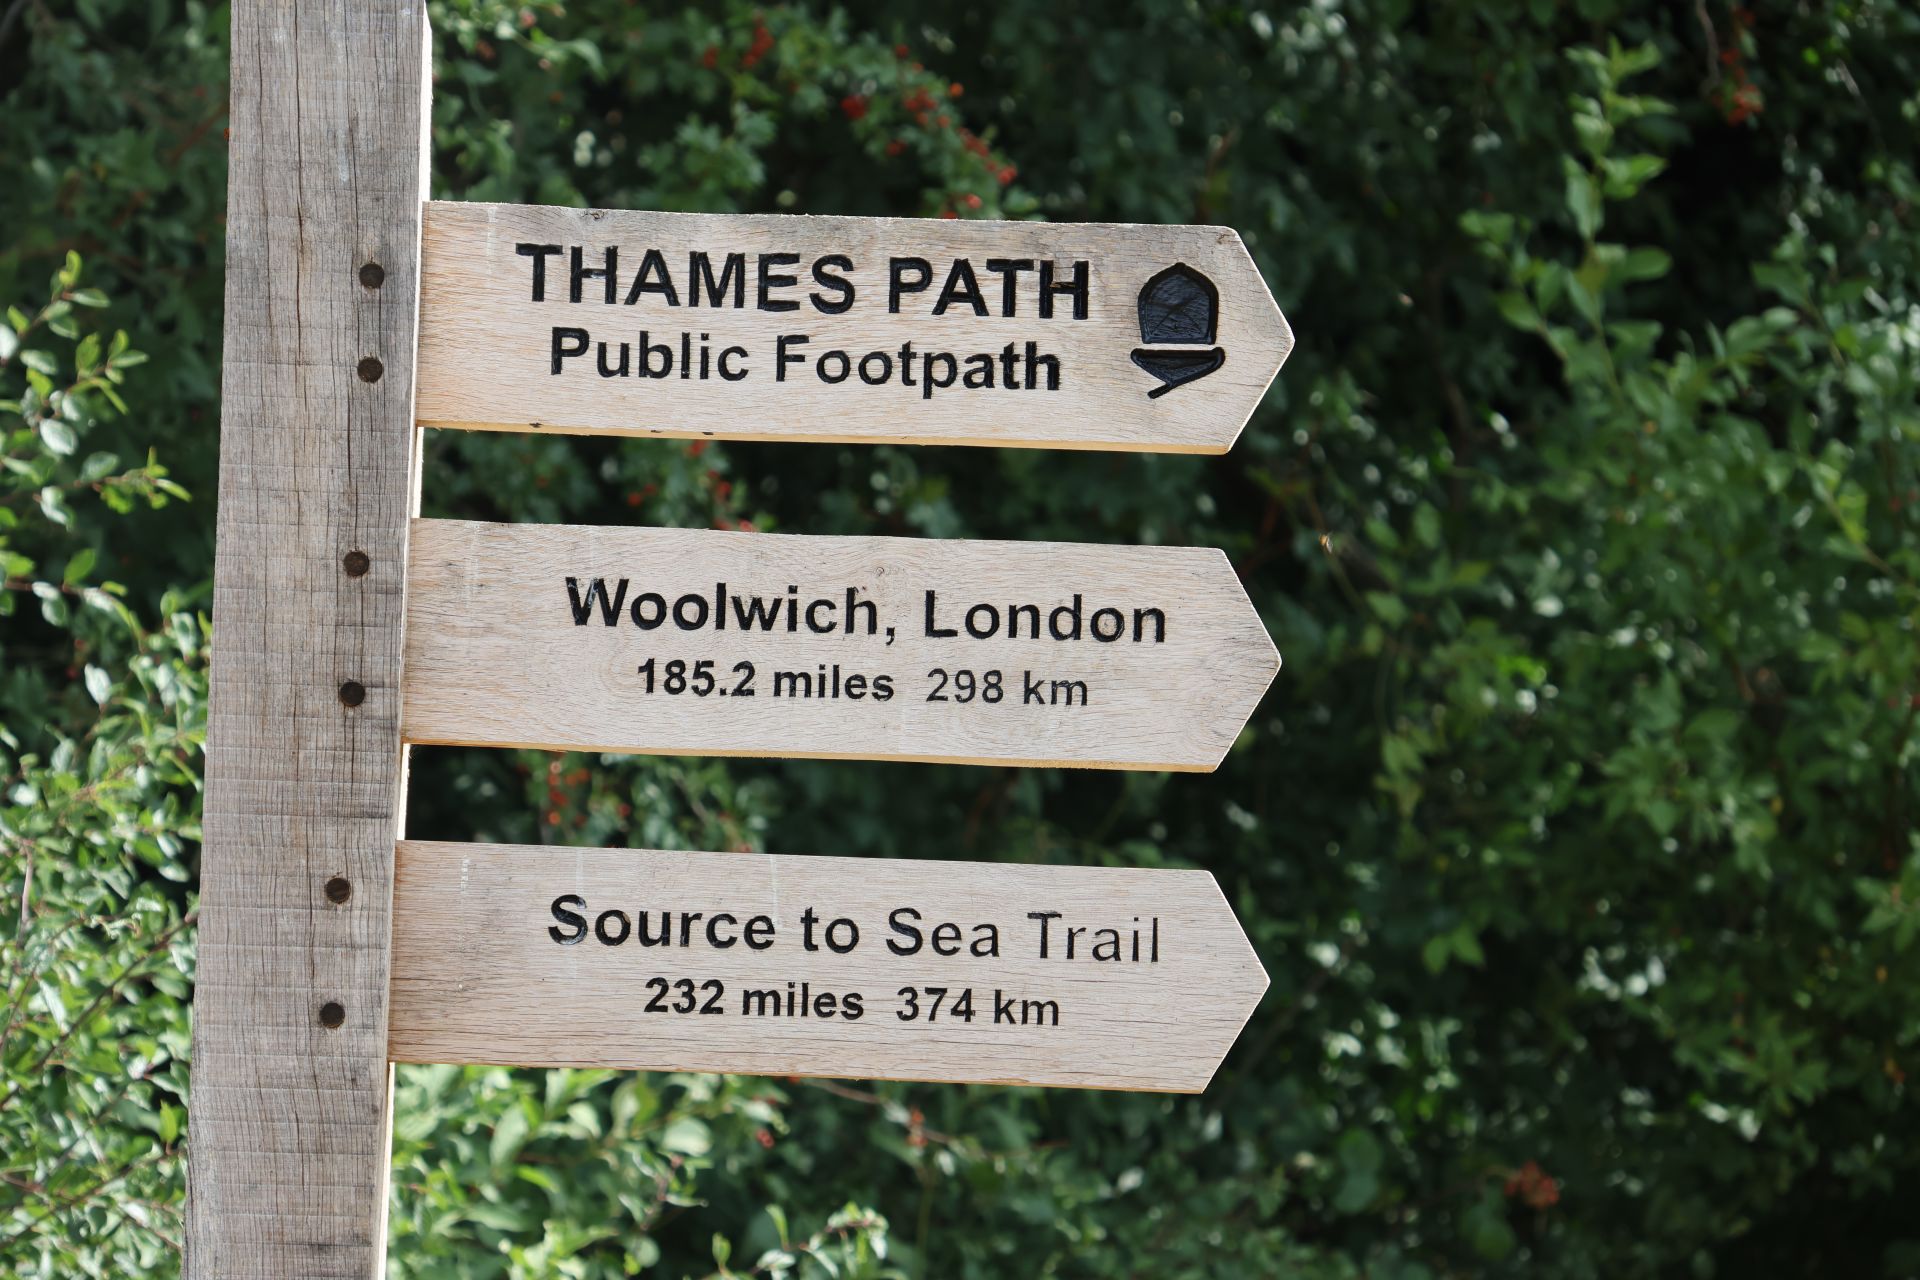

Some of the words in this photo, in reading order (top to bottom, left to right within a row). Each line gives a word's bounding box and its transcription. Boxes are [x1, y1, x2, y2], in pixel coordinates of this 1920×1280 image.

[515, 242, 857, 315] THAMES
[888, 256, 1090, 321] PATH
[551, 326, 750, 382] Public
[775, 334, 1061, 400] Footpath
[565, 576, 896, 646] Woolwich,
[924, 589, 1166, 643] London
[637, 657, 756, 698] 185.2
[773, 663, 895, 702] miles
[925, 668, 1004, 704] 298
[1023, 670, 1088, 706] km
[547, 894, 776, 951] Source
[800, 906, 861, 954] to
[885, 907, 1001, 958] Sea
[1027, 911, 1159, 963] Trail
[643, 977, 725, 1015] 232
[742, 981, 864, 1021] miles
[896, 986, 976, 1023] 374
[993, 989, 1061, 1026] km
